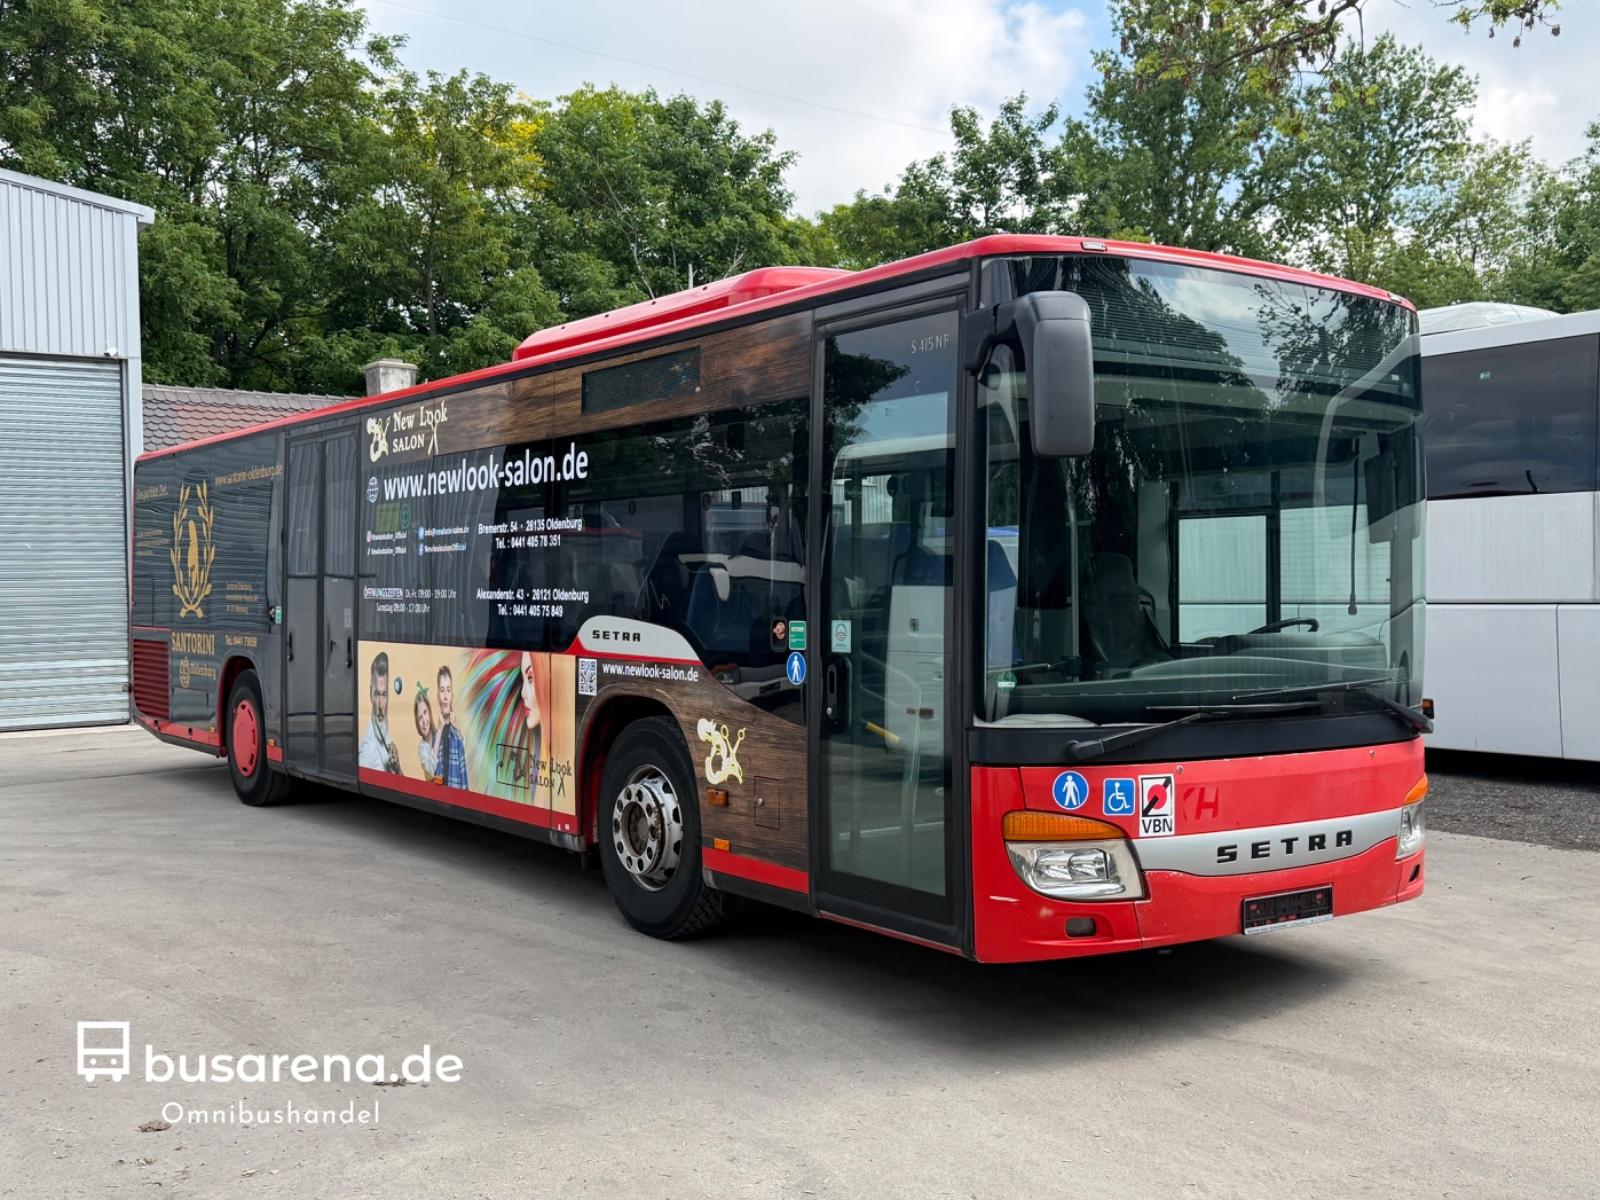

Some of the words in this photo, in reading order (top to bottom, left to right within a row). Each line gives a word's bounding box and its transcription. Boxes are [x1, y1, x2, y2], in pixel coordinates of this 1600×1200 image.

[393, 410, 415, 432] New
[419, 400, 448, 427] Look
[392, 433, 425, 453] SALON
[383, 442, 589, 501] www.newlook-salon.de
[478, 523, 509, 534] Bremerstr.
[510, 521, 518, 532] 54
[525, 519, 545, 531] 26135
[546, 517, 583, 531] Oldenburg
[511, 536, 526, 548] 0441
[527, 535, 538, 547] 405
[549, 534, 561, 546] 351
[476, 588, 515, 600] Alexanderstr.
[516, 589, 524, 600] 43
[532, 589, 551, 601] 26121
[552, 589, 590, 604] Oldenburg
[513, 605, 527, 616] 0441
[528, 605, 541, 617] 405
[542, 605, 550, 617] 75
[551, 605, 563, 617] 849
[171, 631, 215, 655] SANTORINI
[592, 629, 641, 642] SETRA
[190, 662, 216, 680] Oldenburg
[602, 663, 699, 682] www.newlook-salon.de
[529, 753, 547, 771] New
[551, 758, 572, 777] Look
[529, 775, 555, 788] SALON
[1141, 818, 1173, 834] VBN
[1217, 829, 1353, 864] SETRA
